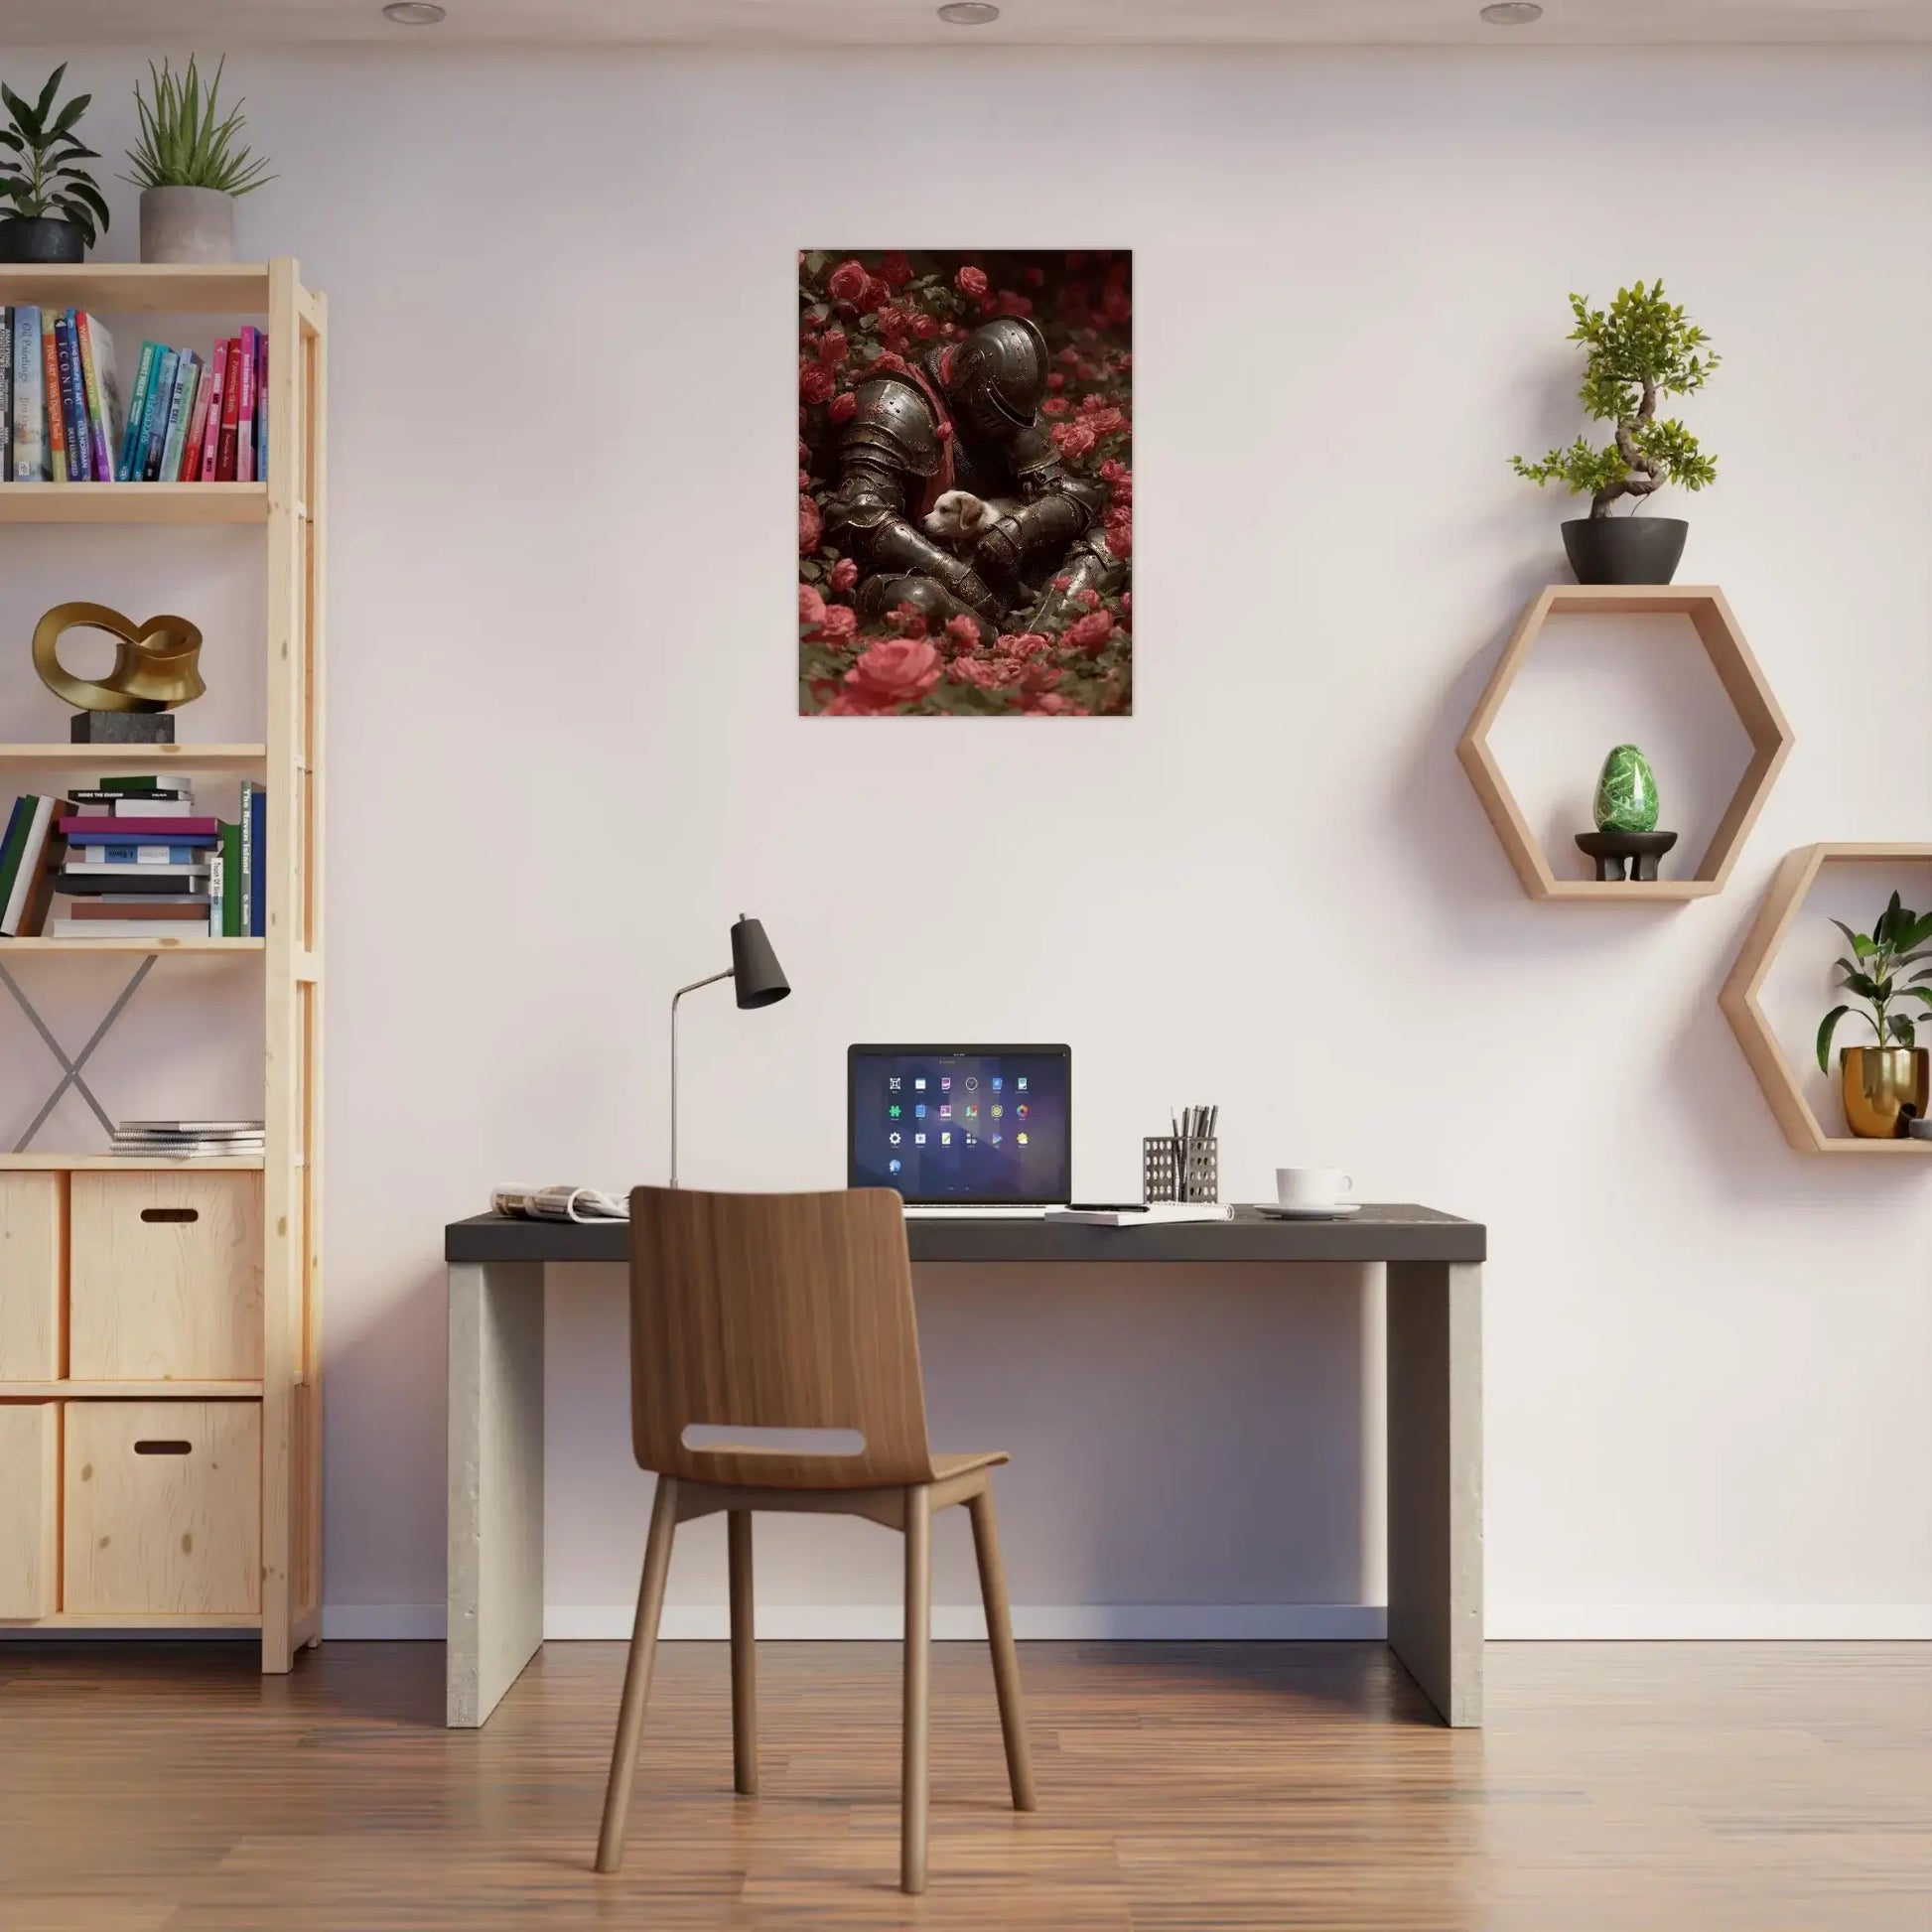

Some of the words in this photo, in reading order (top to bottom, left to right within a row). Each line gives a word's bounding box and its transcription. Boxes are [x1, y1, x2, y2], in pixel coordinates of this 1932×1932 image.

[19, 340, 31, 383] Paintings
[48, 362, 57, 376] ART
[58, 342, 72, 406] ICONIC
[228, 360, 238, 394] Parenting
[49, 382, 58, 399] With
[50, 399, 60, 421] Digital
[226, 394, 237, 414] Skills
[212, 861, 221, 878] Touch
